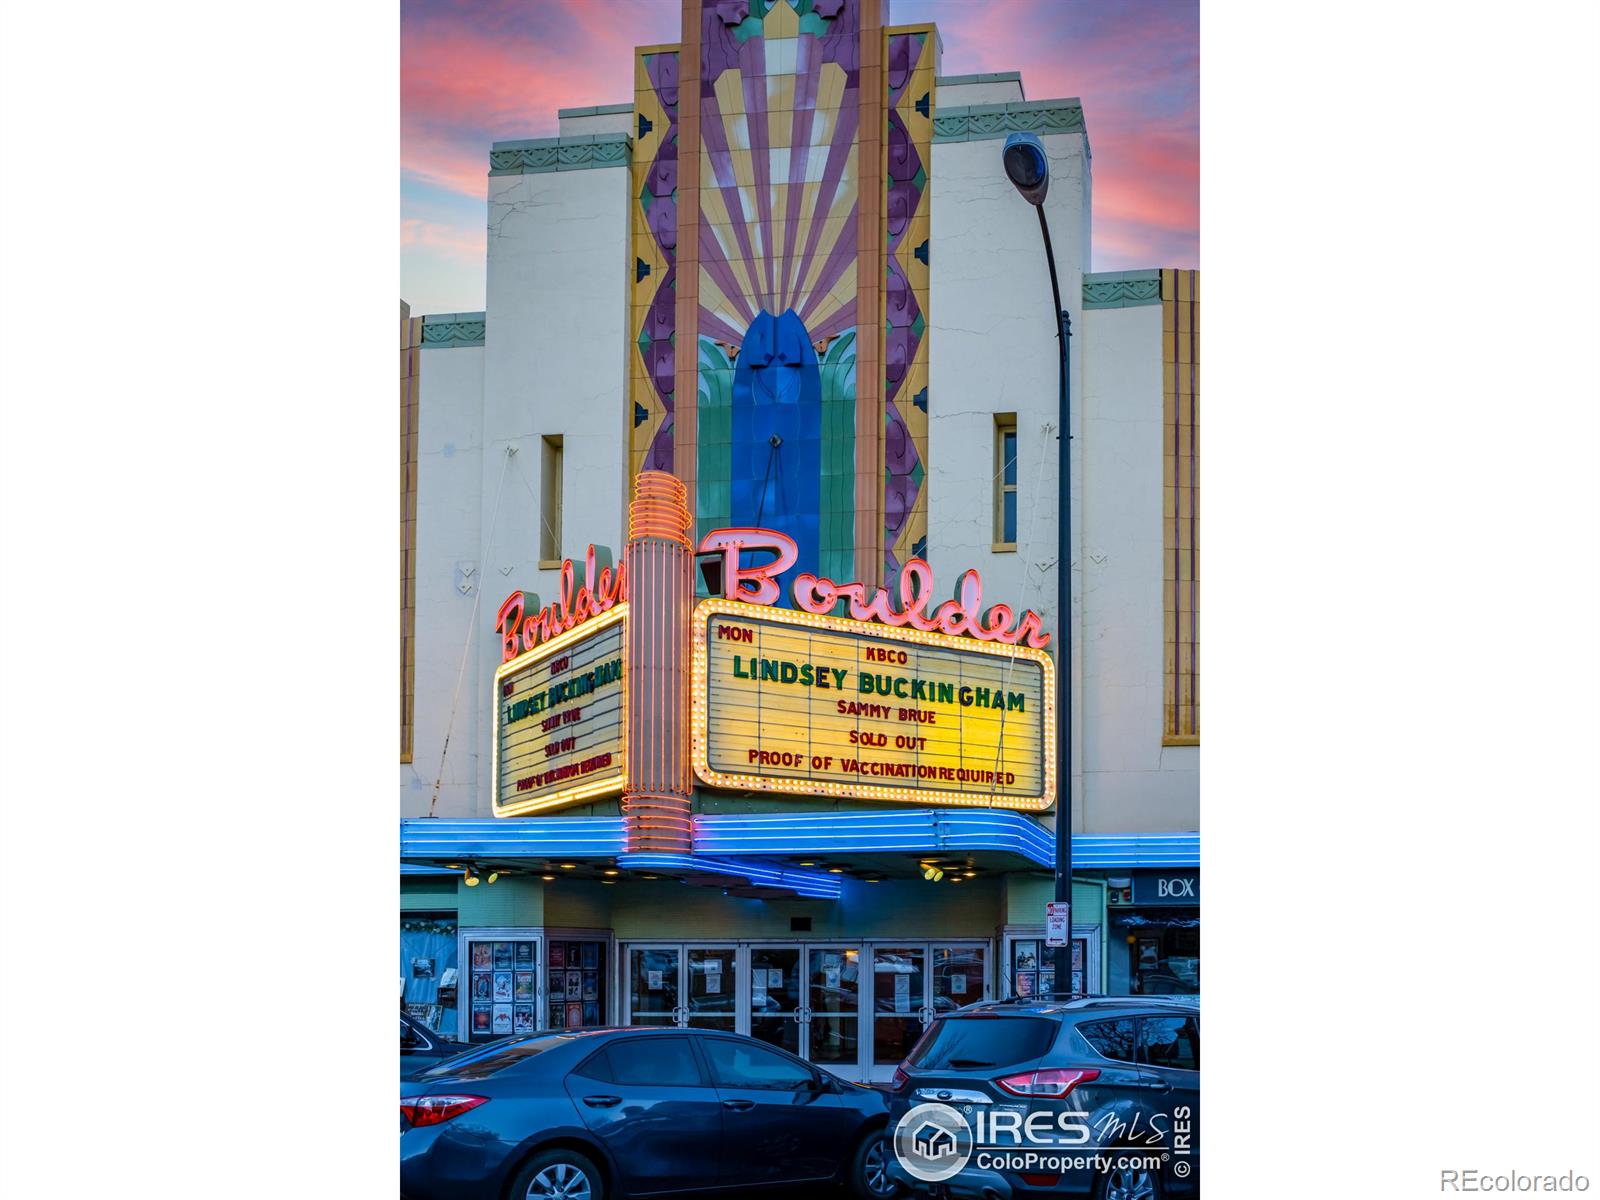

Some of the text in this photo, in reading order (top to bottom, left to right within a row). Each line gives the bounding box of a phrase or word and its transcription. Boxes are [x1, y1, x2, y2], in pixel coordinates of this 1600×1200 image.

[702, 528, 1050, 648] Boulder
[718, 624, 753, 643] MON
[866, 646, 907, 664] KBCO
[733, 655, 1025, 713] LINDSEY BUCKINGHAM
[837, 699, 936, 724] SAMMY BRUE
[849, 730, 927, 751] SOLD OUT
[748, 749, 803, 767] PROOF
[811, 756, 833, 770] OF
[1158, 878, 1194, 897] BOX
